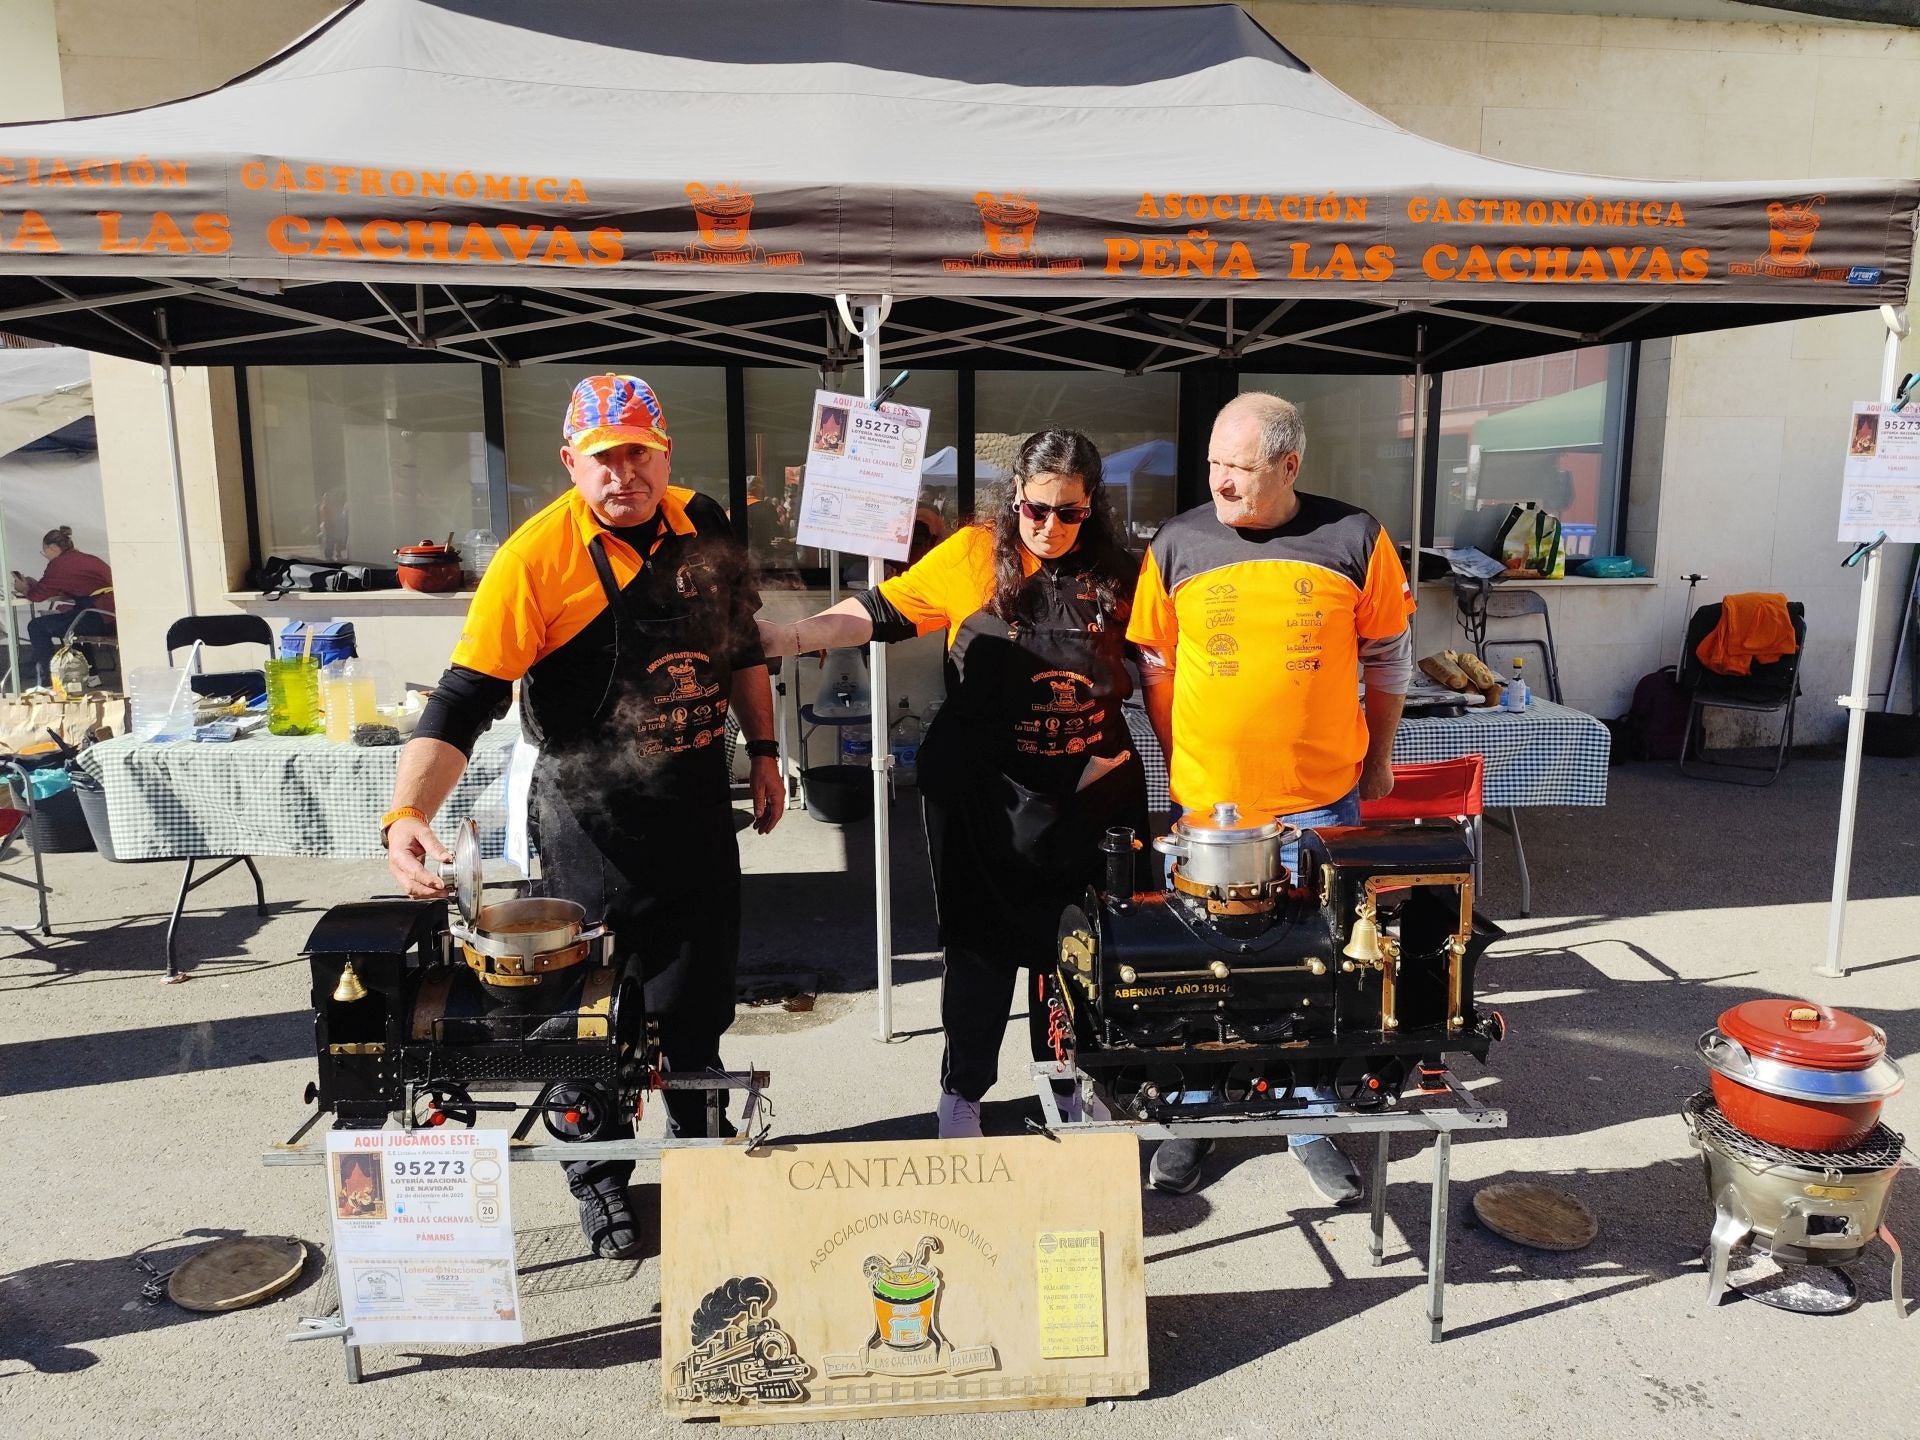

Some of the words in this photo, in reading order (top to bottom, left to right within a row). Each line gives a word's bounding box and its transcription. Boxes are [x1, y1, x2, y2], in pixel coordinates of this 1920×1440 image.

[241, 162, 589, 204] GASTRONÓMICA
[1136, 190, 1368, 224] ASOCIACIÓN
[1407, 194, 1686, 228] GASTRONÓMICA
[96, 211, 233, 255] LAS
[267, 215, 625, 266] CACHAVAS
[657, 252, 685, 262] PEÑA
[699, 251, 712, 262] LAS
[713, 252, 749, 263] CACHAVAS
[1103, 229, 1260, 279] PEÑA
[1287, 240, 1396, 282] LAS
[1421, 242, 1710, 284] CACHAVAS
[946, 260, 971, 270] PEÑA
[985, 260, 998, 271] LAS
[999, 260, 1033, 271] CACHAVAS
[854, 401, 890, 417] JUGOS
[855, 418, 900, 434] 95273
[1884, 420, 1920, 431] 95273
[904, 457, 912, 465] 20
[1114, 987, 1166, 998] ABERNAT
[1175, 984, 1199, 994] AÑO
[1202, 984, 1227, 993] 1914
[354, 1134, 384, 1148] AQUÍ
[388, 1134, 446, 1148] JUGAMOS
[450, 1134, 480, 1146] ESTE:
[394, 1160, 465, 1176] 95273
[788, 1152, 1015, 1190] CANTABRIA
[482, 1207, 494, 1215] 20
[393, 1215, 414, 1224] PEÑA
[416, 1215, 431, 1224] LAS
[432, 1215, 474, 1224] CACHAVAS
[416, 1233, 455, 1241] PÁMANES
[809, 1211, 888, 1273] ASOCIACION
[893, 1209, 999, 1267] GASTRONOMICA
[1059, 1236, 1099, 1249] RENFE
